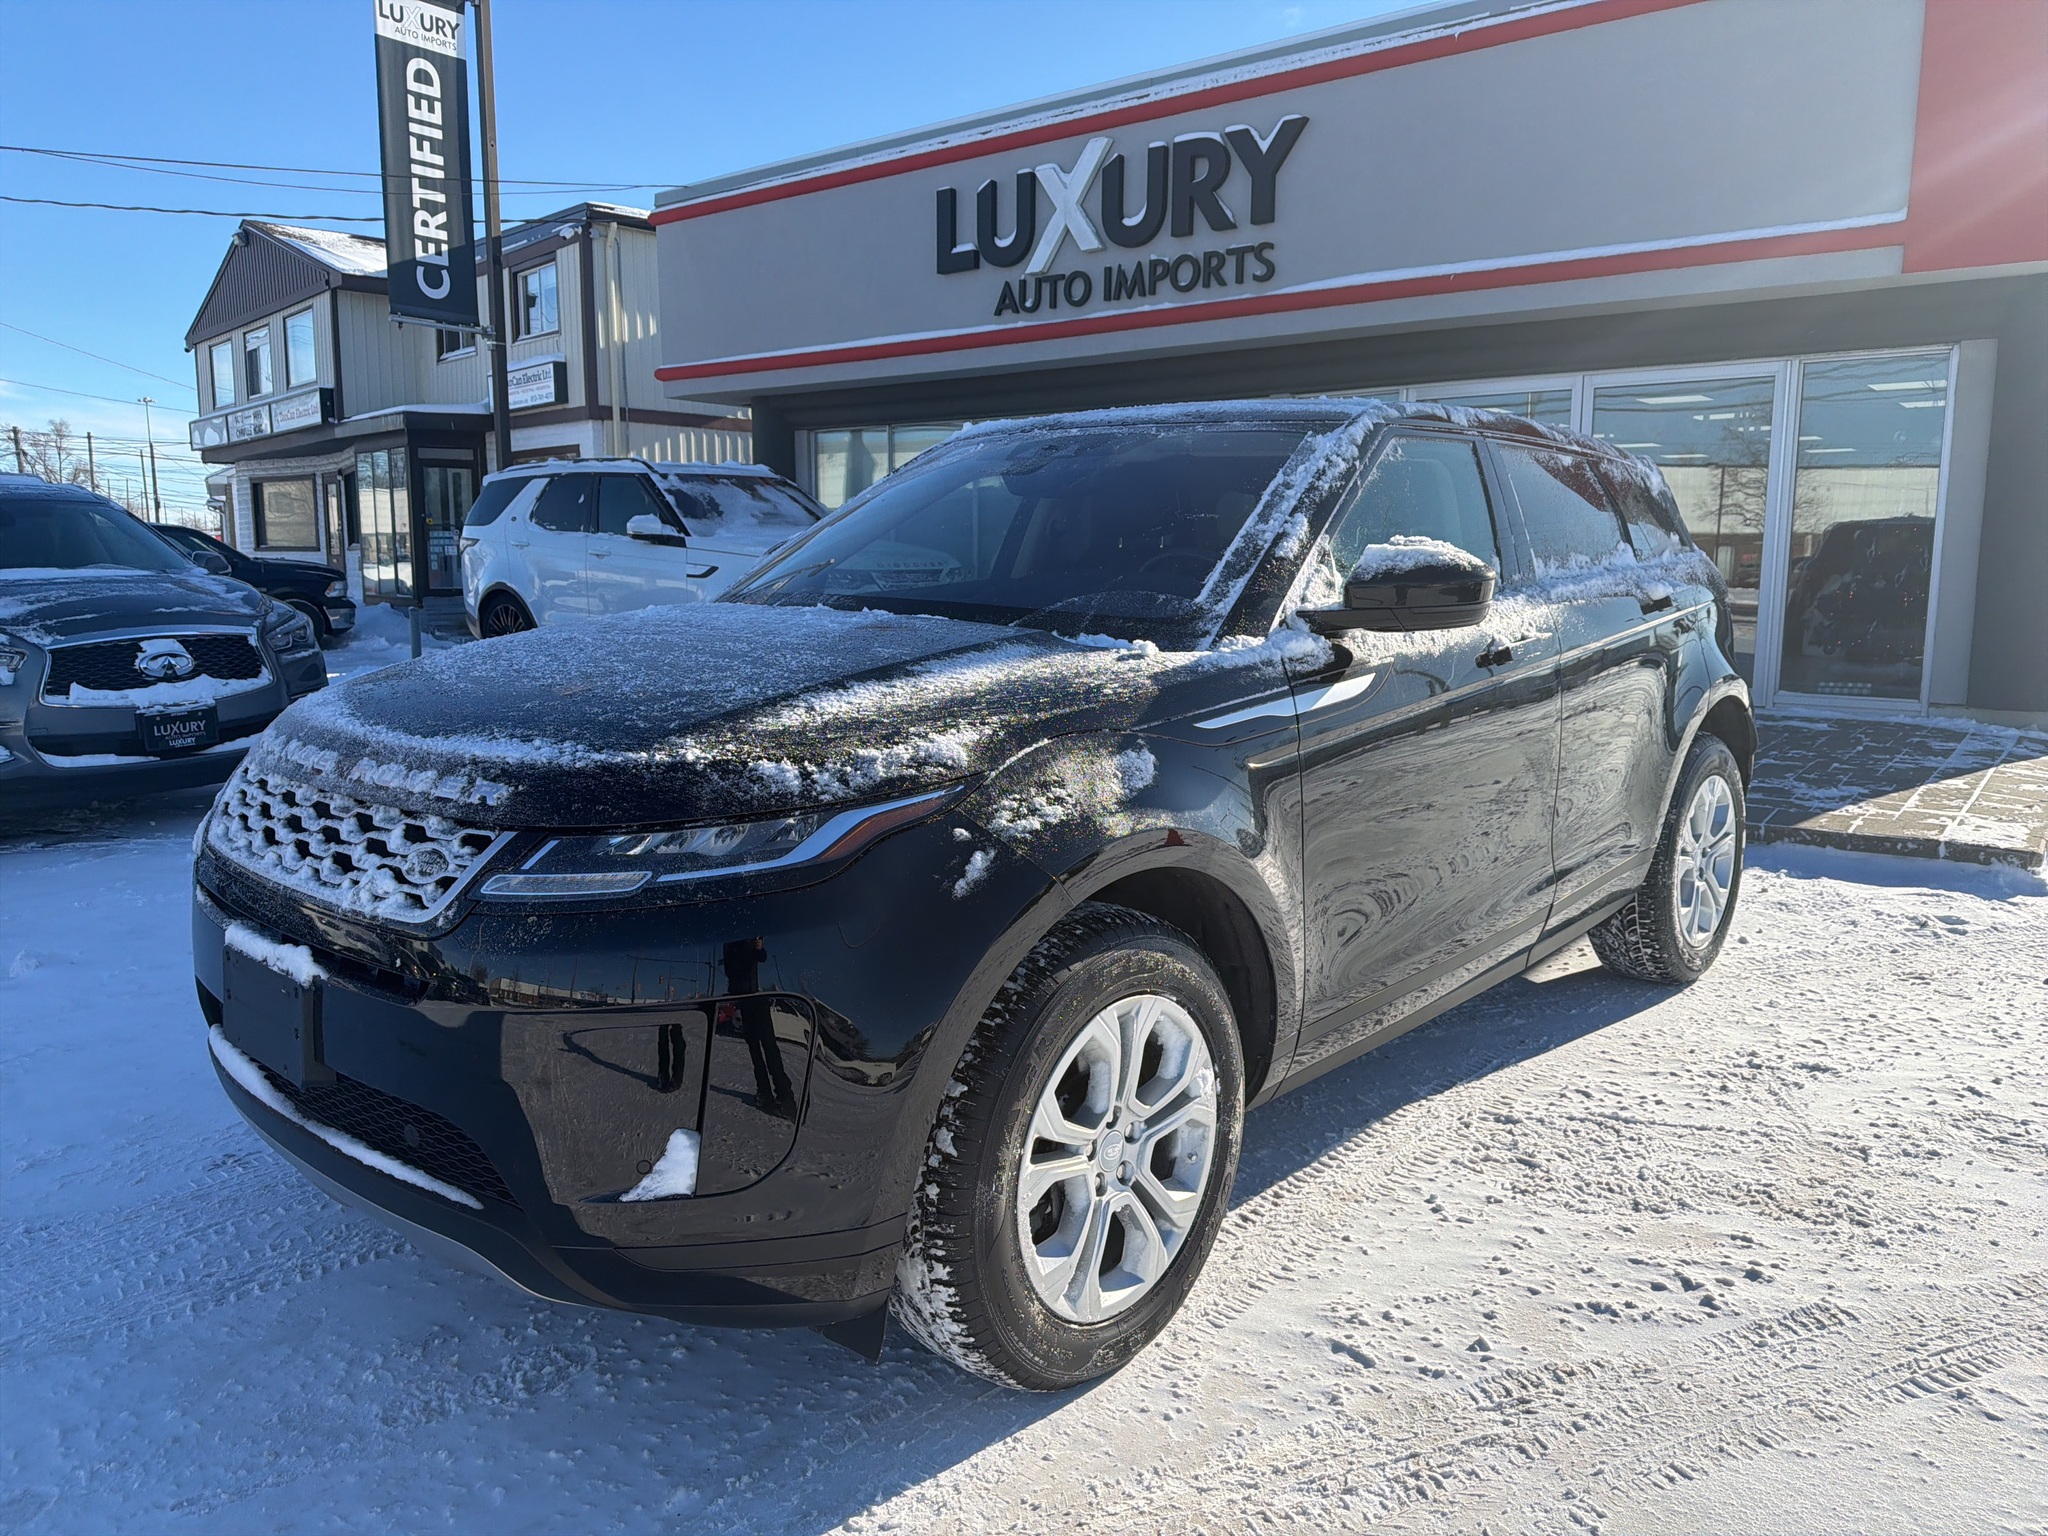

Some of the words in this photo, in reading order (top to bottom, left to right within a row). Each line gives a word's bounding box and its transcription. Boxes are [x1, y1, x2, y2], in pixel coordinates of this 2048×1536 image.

[379, 0, 460, 40] LUXURY
[395, 26, 418, 39] AUTO
[421, 34, 456, 51] IMPORTS
[406, 57, 450, 300] CERTIFIED
[936, 114, 1309, 275] LUXURY
[994, 269, 1092, 316] AUTO
[1103, 242, 1275, 302] IMPORTS
[522, 371, 542, 384] Electric
[154, 720, 206, 736] LUXURY
[169, 737, 196, 746] LUXURY
